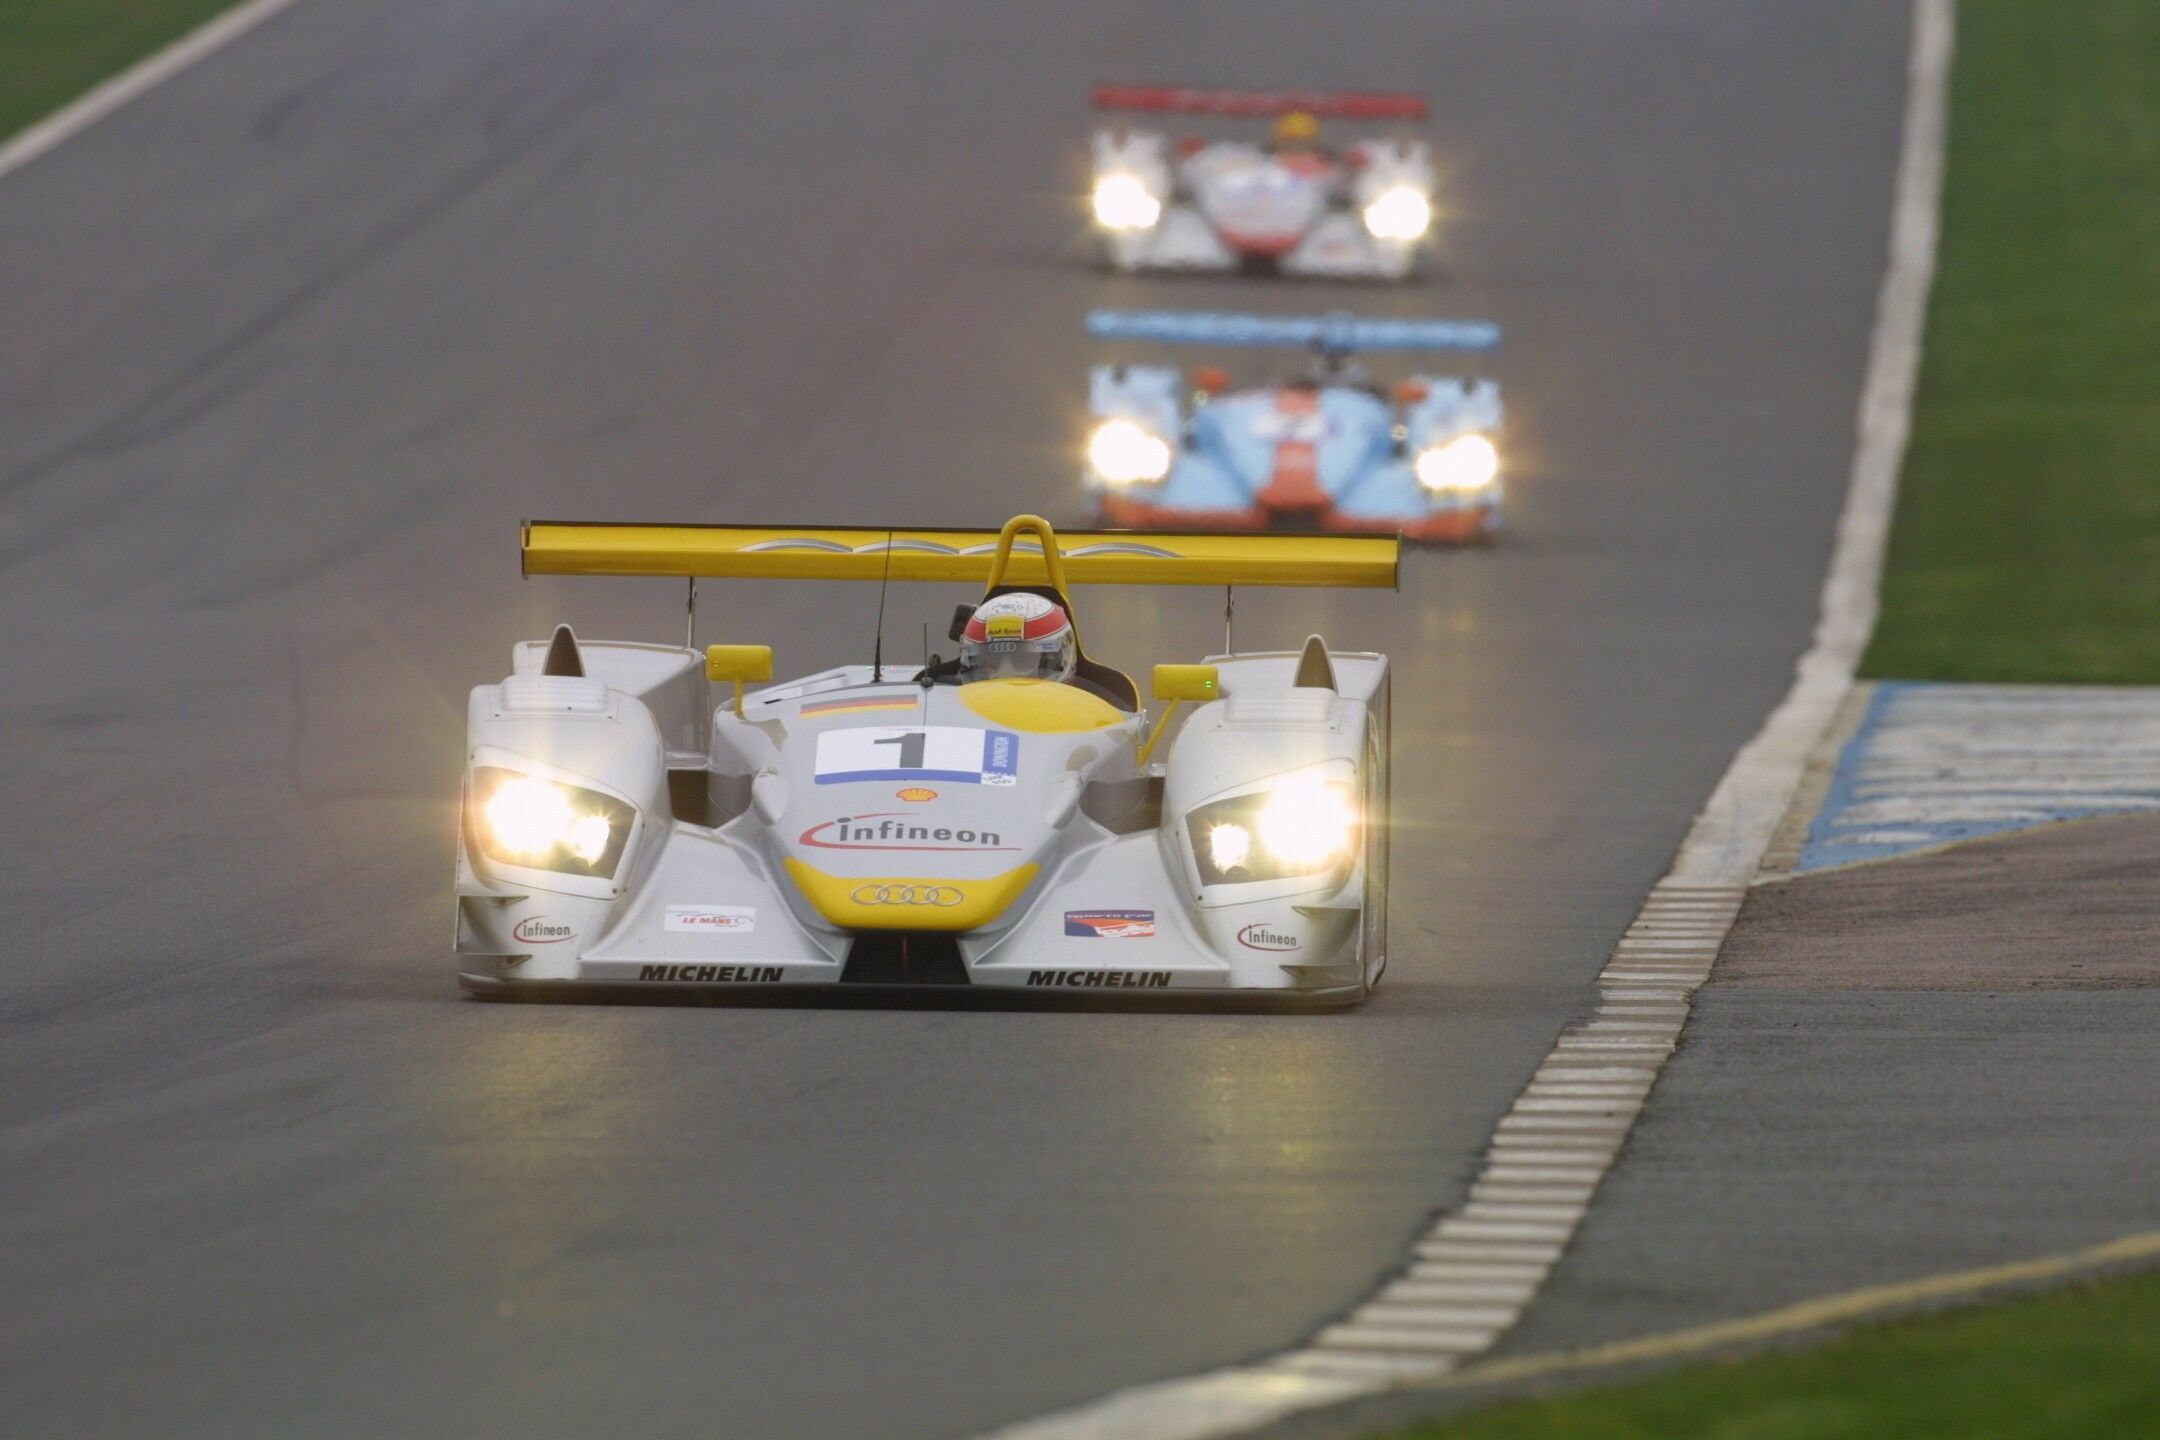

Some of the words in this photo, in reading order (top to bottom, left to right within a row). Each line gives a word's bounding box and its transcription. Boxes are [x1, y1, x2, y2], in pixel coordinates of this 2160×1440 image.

[873, 732, 926, 769] 1
[836, 816, 1001, 846] infineon
[638, 964, 785, 983] MICHELIN
[1026, 970, 1173, 988] MICHELIN
